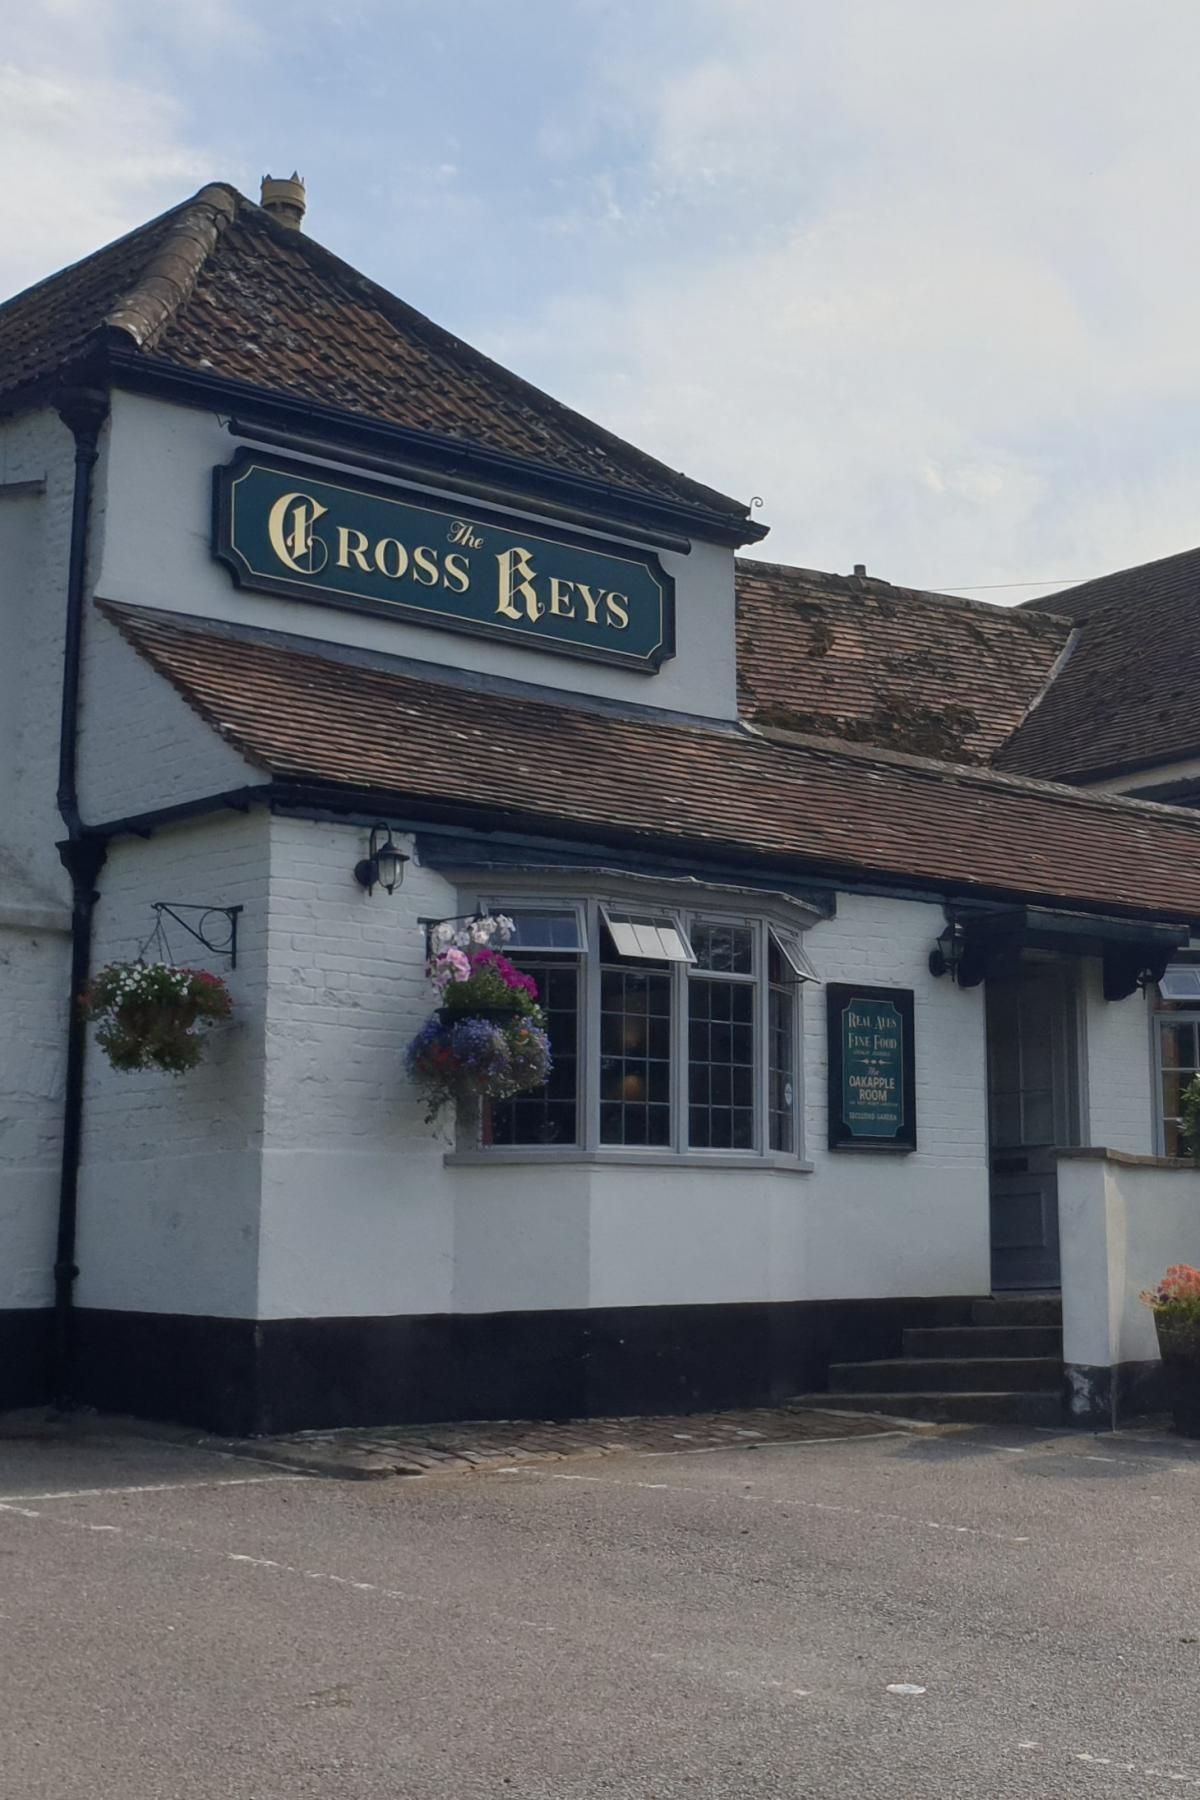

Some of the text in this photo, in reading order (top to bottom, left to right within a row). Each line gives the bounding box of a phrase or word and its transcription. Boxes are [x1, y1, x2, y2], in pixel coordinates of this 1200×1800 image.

[446, 520, 486, 551] The
[268, 492, 630, 630] CROSS KEYS
[849, 1075, 895, 1089] OAKAPPLE
[859, 1089, 887, 1102] ROOM
